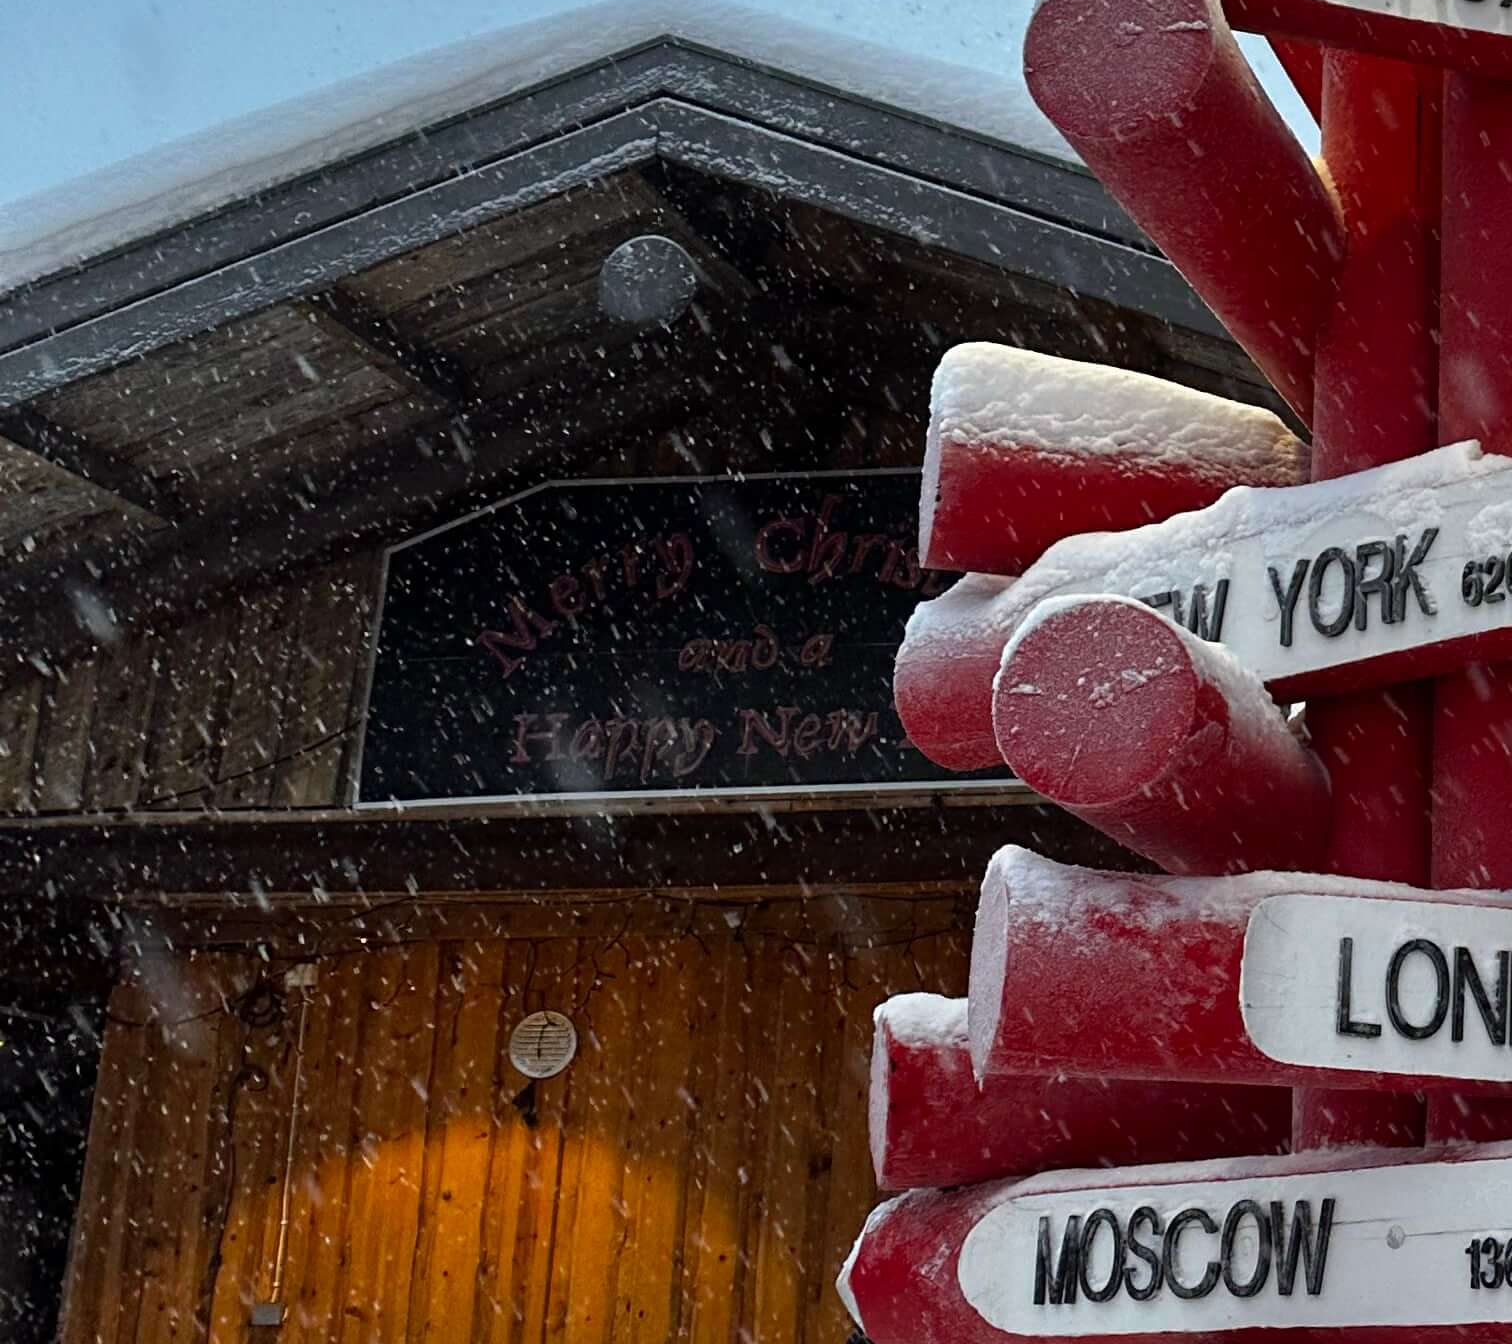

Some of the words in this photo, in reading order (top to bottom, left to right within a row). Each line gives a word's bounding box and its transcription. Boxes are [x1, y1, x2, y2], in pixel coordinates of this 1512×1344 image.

[477, 531, 696, 679] Merry
[1267, 527, 1440, 647] YORK
[678, 623, 781, 673] and
[800, 628, 834, 667] a
[510, 711, 720, 784] Happy
[735, 706, 880, 755] New
[1032, 1197, 1336, 1306] MOSCOW
